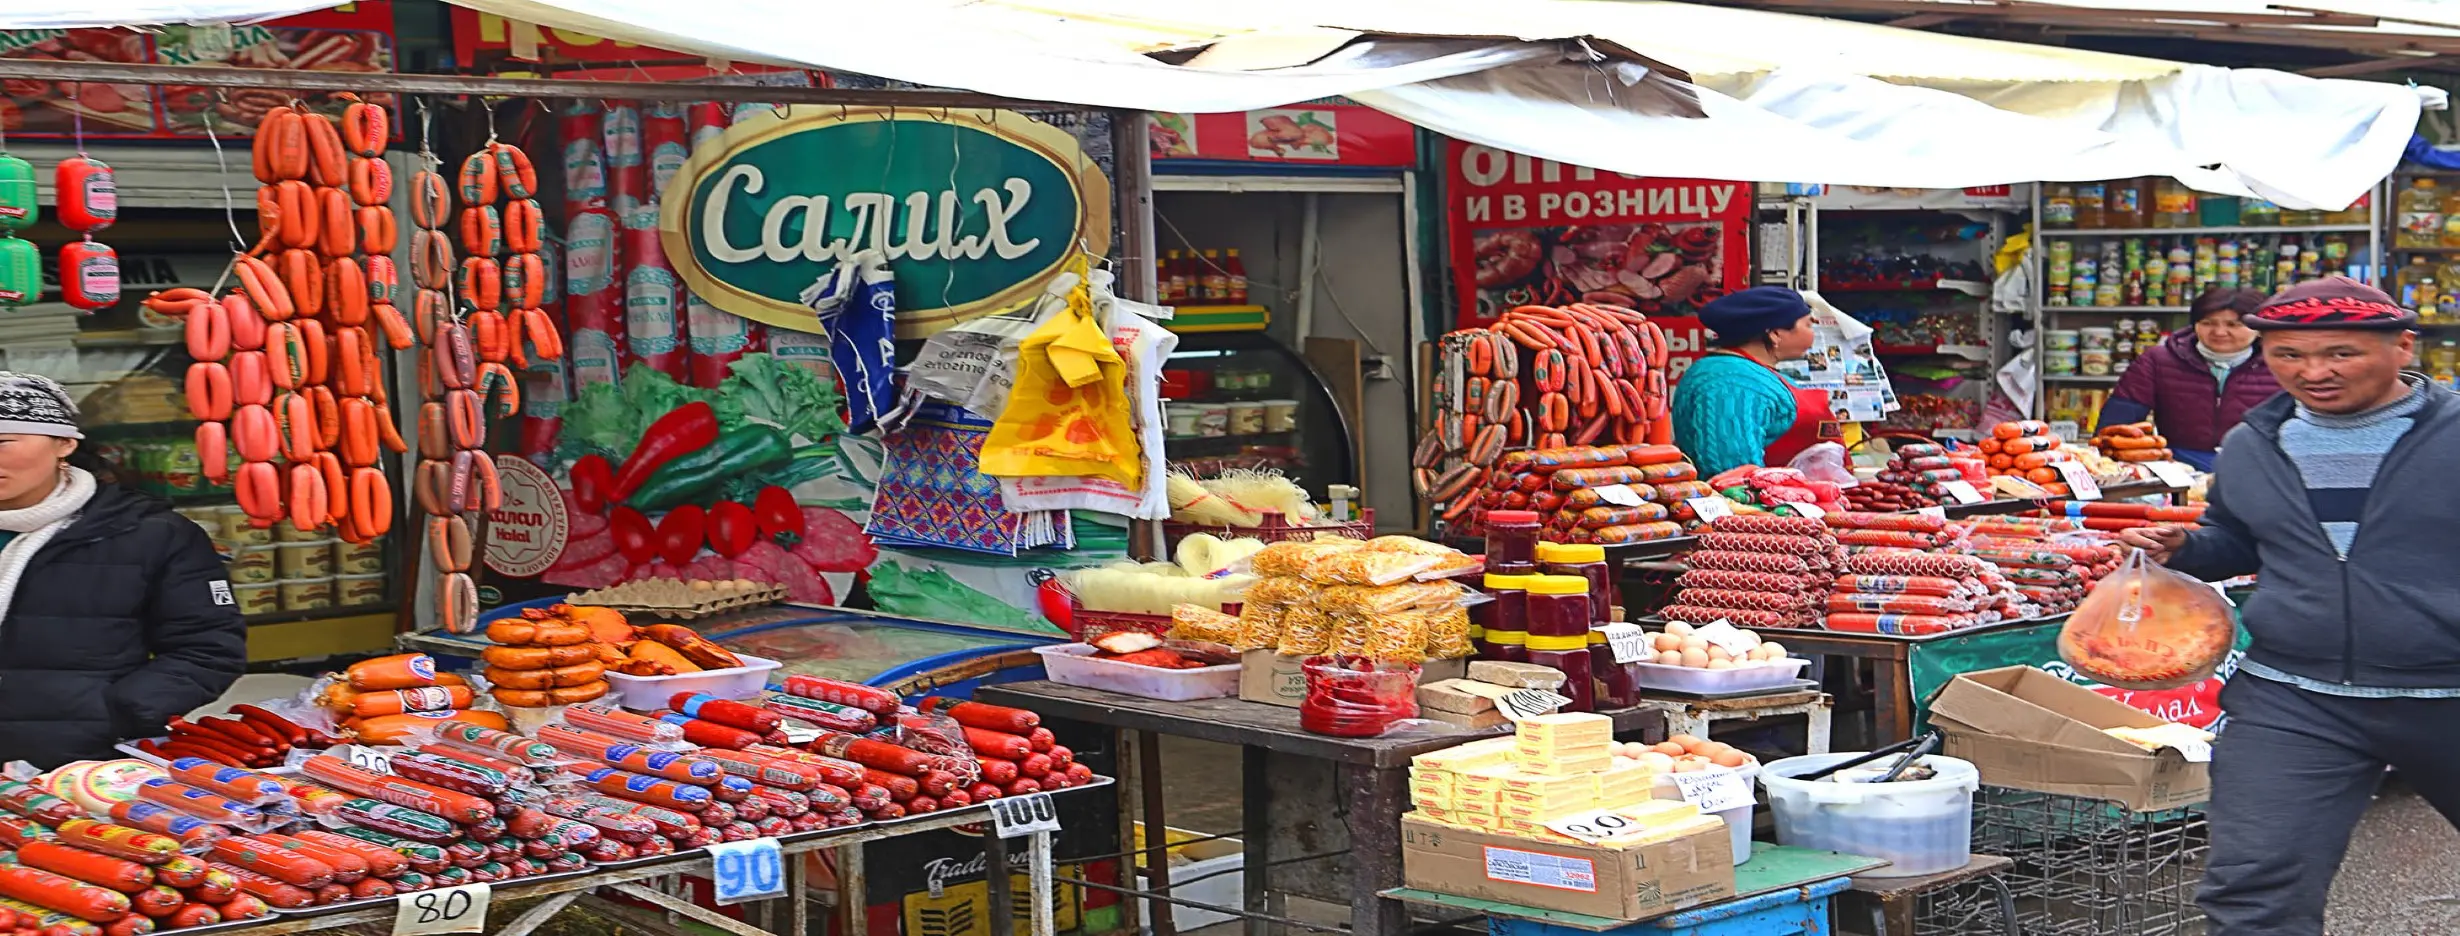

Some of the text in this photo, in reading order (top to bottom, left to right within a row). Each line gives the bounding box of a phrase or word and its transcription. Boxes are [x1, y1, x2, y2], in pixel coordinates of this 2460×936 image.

[157, 24, 273, 65] Хал
[703, 163, 1040, 263] Салих
[1466, 184, 1735, 222] И В РОЗНИЦУ
[495, 526, 532, 543] Halal
[993, 794, 1056, 828] 100
[717, 844, 780, 897] 90
[414, 888, 472, 924] 80
